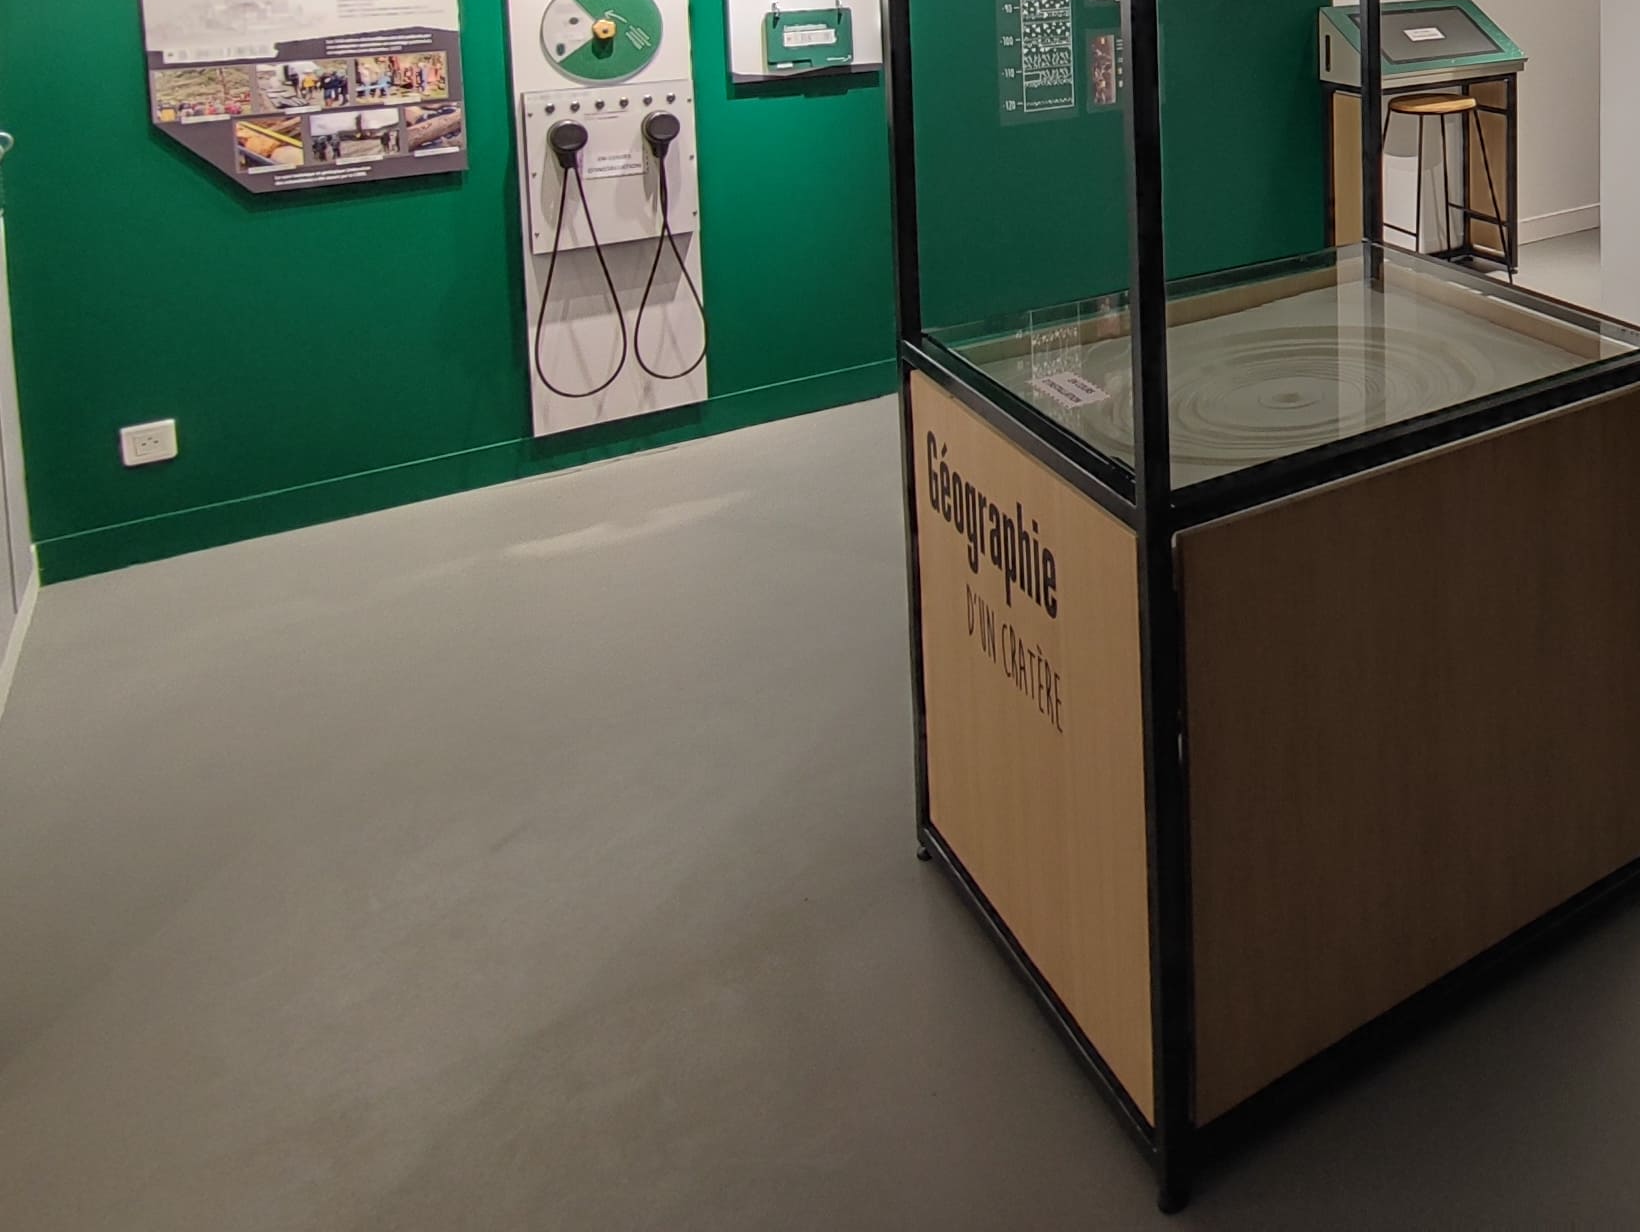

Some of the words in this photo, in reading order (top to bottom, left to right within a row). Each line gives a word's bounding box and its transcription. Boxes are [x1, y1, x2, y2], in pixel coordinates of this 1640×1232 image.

[926, 430, 1059, 619] Géographie
[966, 583, 997, 664] D'UN
[1001, 622, 1064, 735] CRATÈRE
